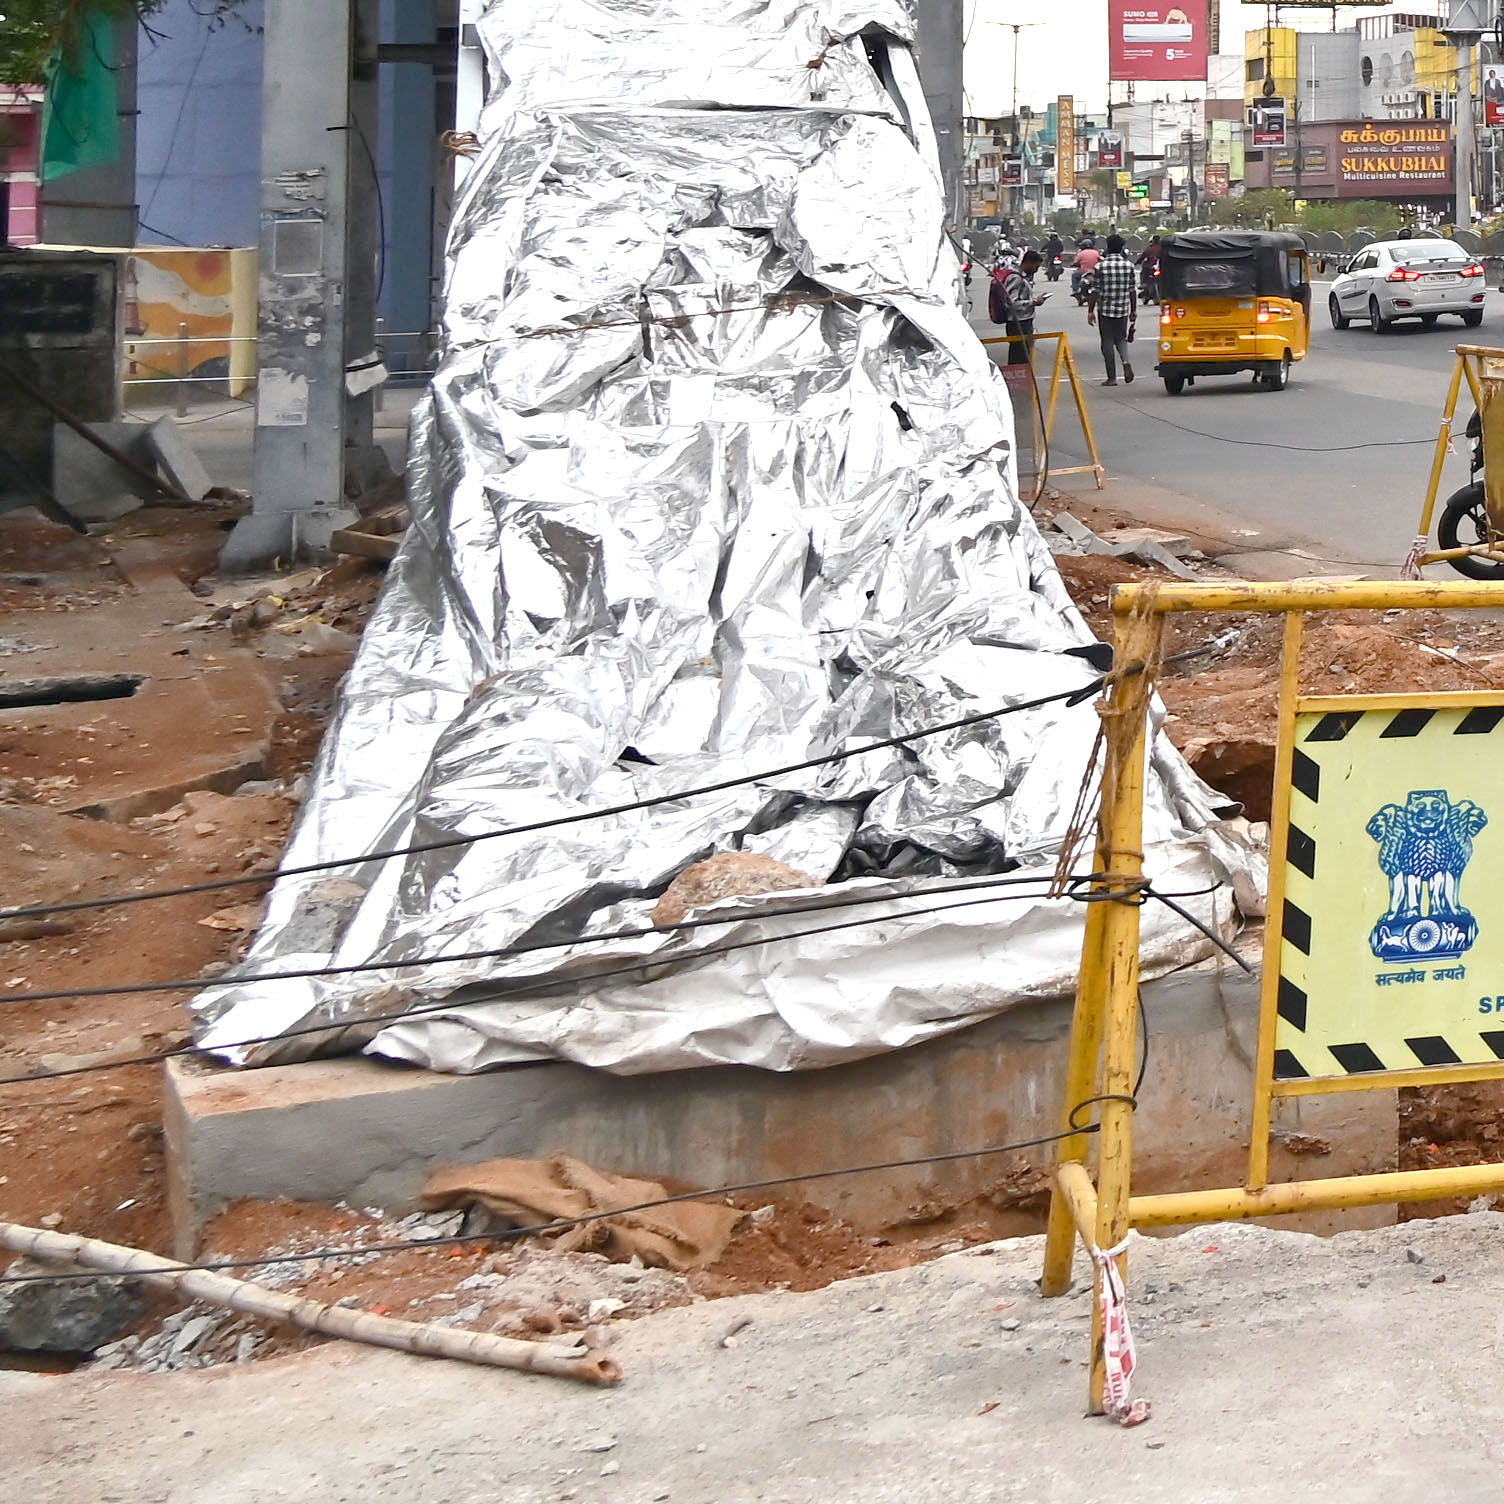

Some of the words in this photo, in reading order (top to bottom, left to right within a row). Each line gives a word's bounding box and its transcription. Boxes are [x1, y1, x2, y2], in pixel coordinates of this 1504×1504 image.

[1123, 10, 1146, 18] SUMO
[1166, 48, 1175, 61] 5
[1061, 101, 1072, 146] AMMAN
[1061, 151, 1072, 187] MESS
[1341, 156, 1446, 173] SUKKUBHAI
[1343, 172, 1397, 181] Multicuisine
[1399, 171, 1446, 179] Restaurant
[1375, 968, 1427, 986] सत्यमेव
[1432, 964, 1467, 981] जयते
